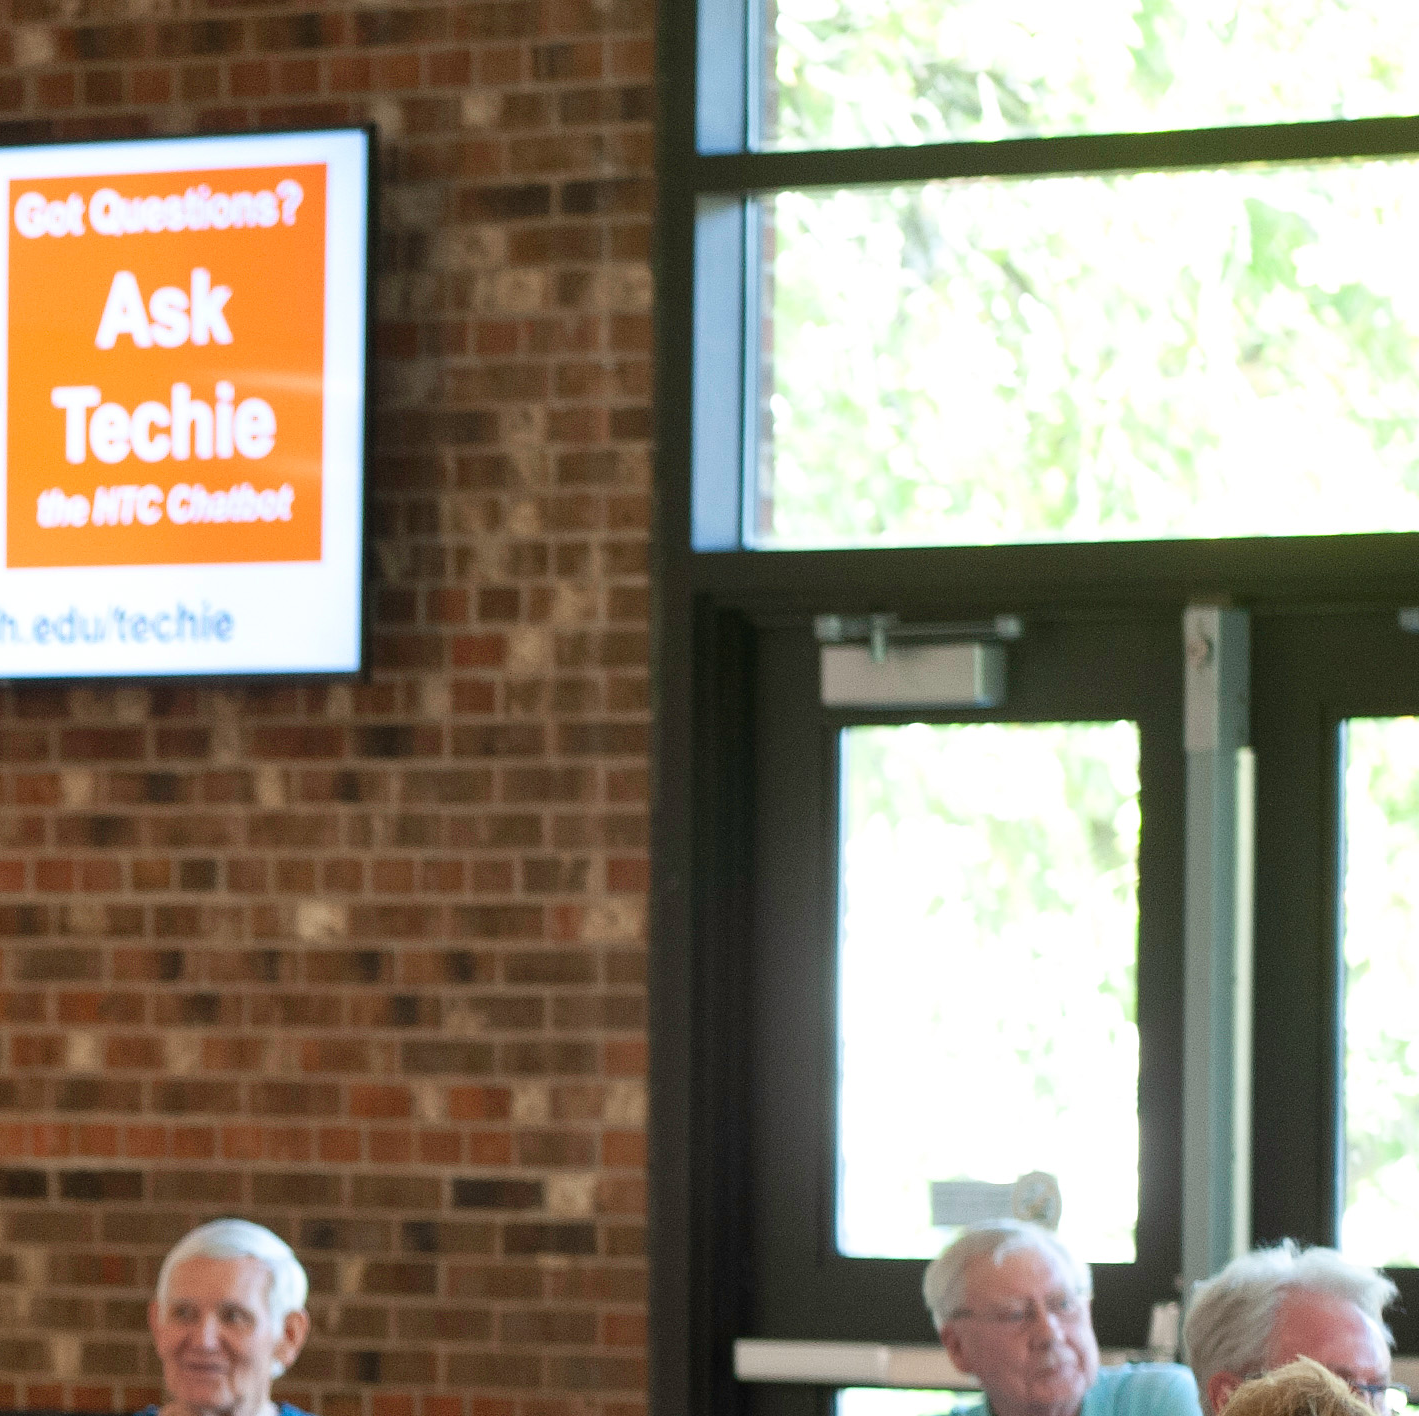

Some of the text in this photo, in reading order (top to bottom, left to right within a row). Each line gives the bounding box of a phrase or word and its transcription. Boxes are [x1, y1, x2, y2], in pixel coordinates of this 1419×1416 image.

[14, 179, 304, 239] Got Questions?
[96, 267, 233, 350] Ask
[51, 380, 276, 464] Techie
[36, 487, 90, 529] the
[166, 482, 295, 524] Chatbot
